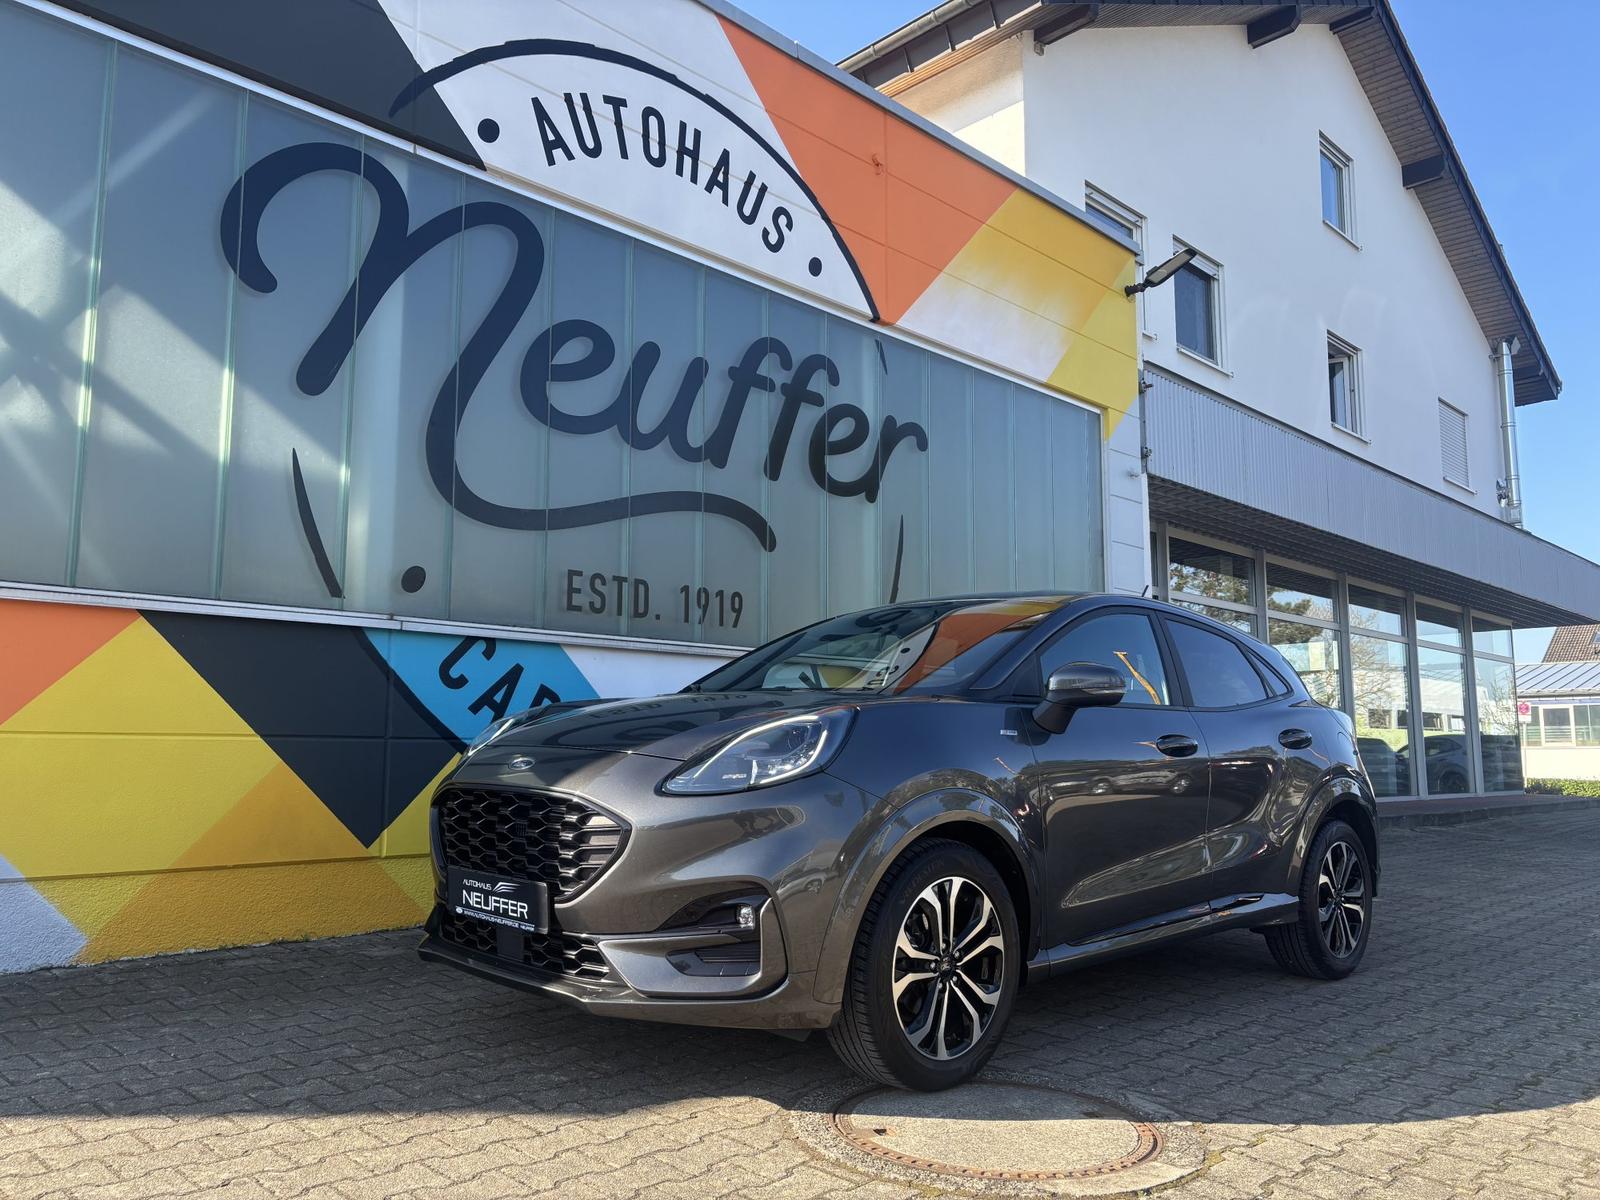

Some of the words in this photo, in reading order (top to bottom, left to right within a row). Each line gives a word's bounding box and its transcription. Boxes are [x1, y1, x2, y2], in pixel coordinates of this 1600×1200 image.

[531, 92, 793, 253] AUTOHAUS
[566, 569, 661, 620] ESTD.
[679, 584, 744, 628] 1919
[463, 879, 492, 891] AUTOHAUS
[463, 889, 528, 920] NEUFFER
